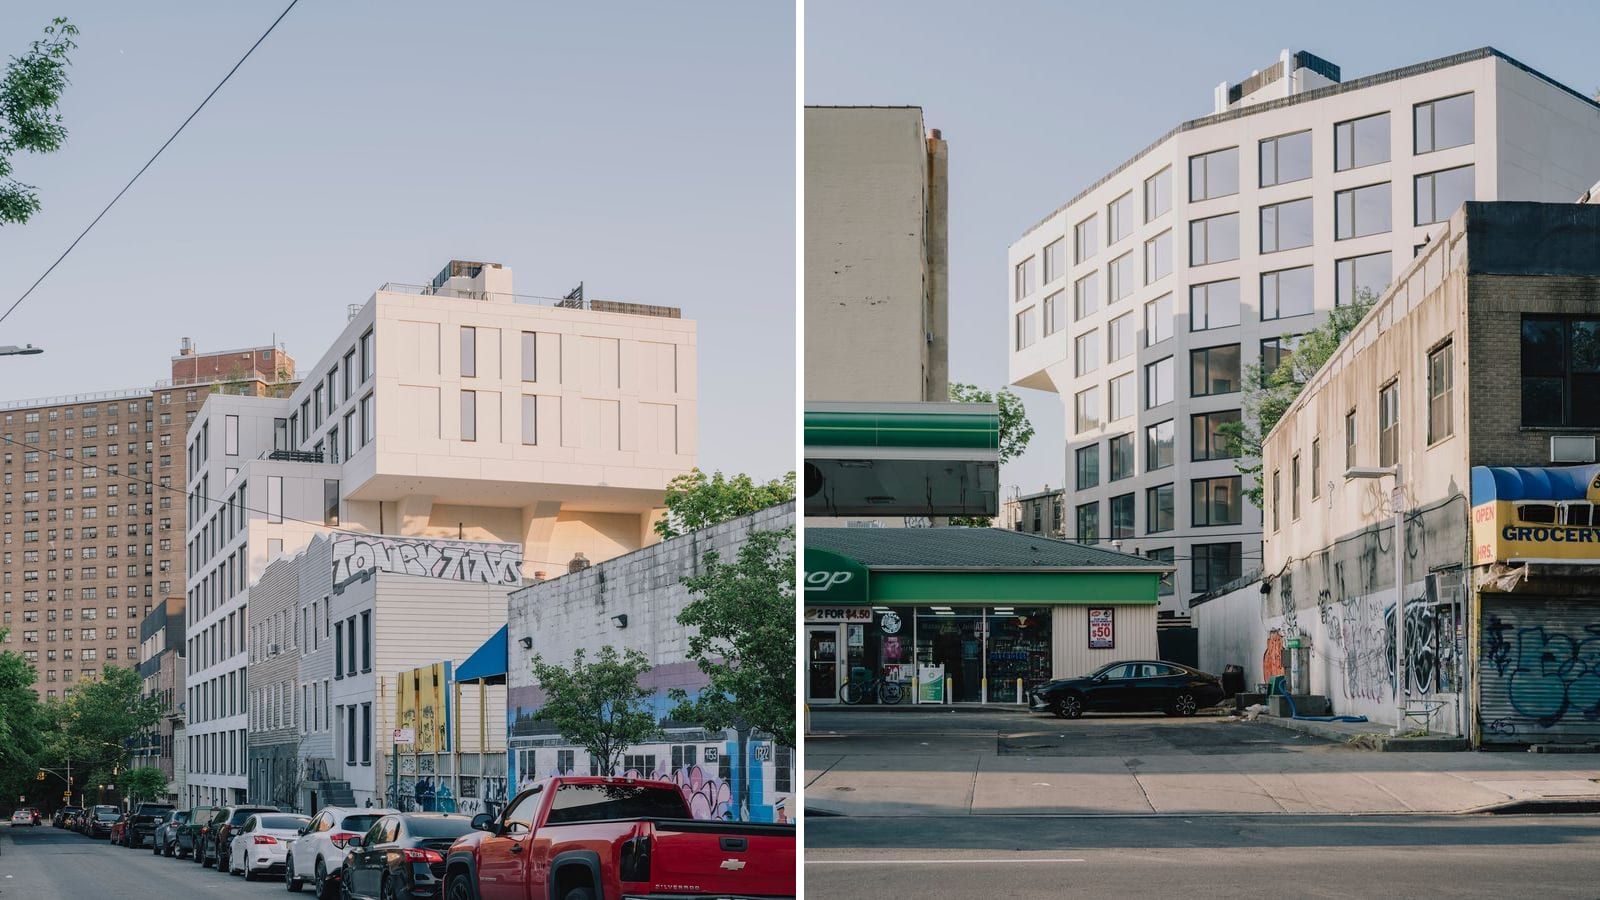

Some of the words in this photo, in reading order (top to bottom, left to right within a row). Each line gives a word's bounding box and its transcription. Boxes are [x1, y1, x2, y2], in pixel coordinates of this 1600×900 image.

[1475, 505, 1495, 524] OPEN
[1477, 544, 1493, 560] HRS.
[804, 571, 852, 591] op
[817, 608, 824, 619] 2
[825, 608, 844, 619] FOR
[845, 608, 870, 620] $4.50
